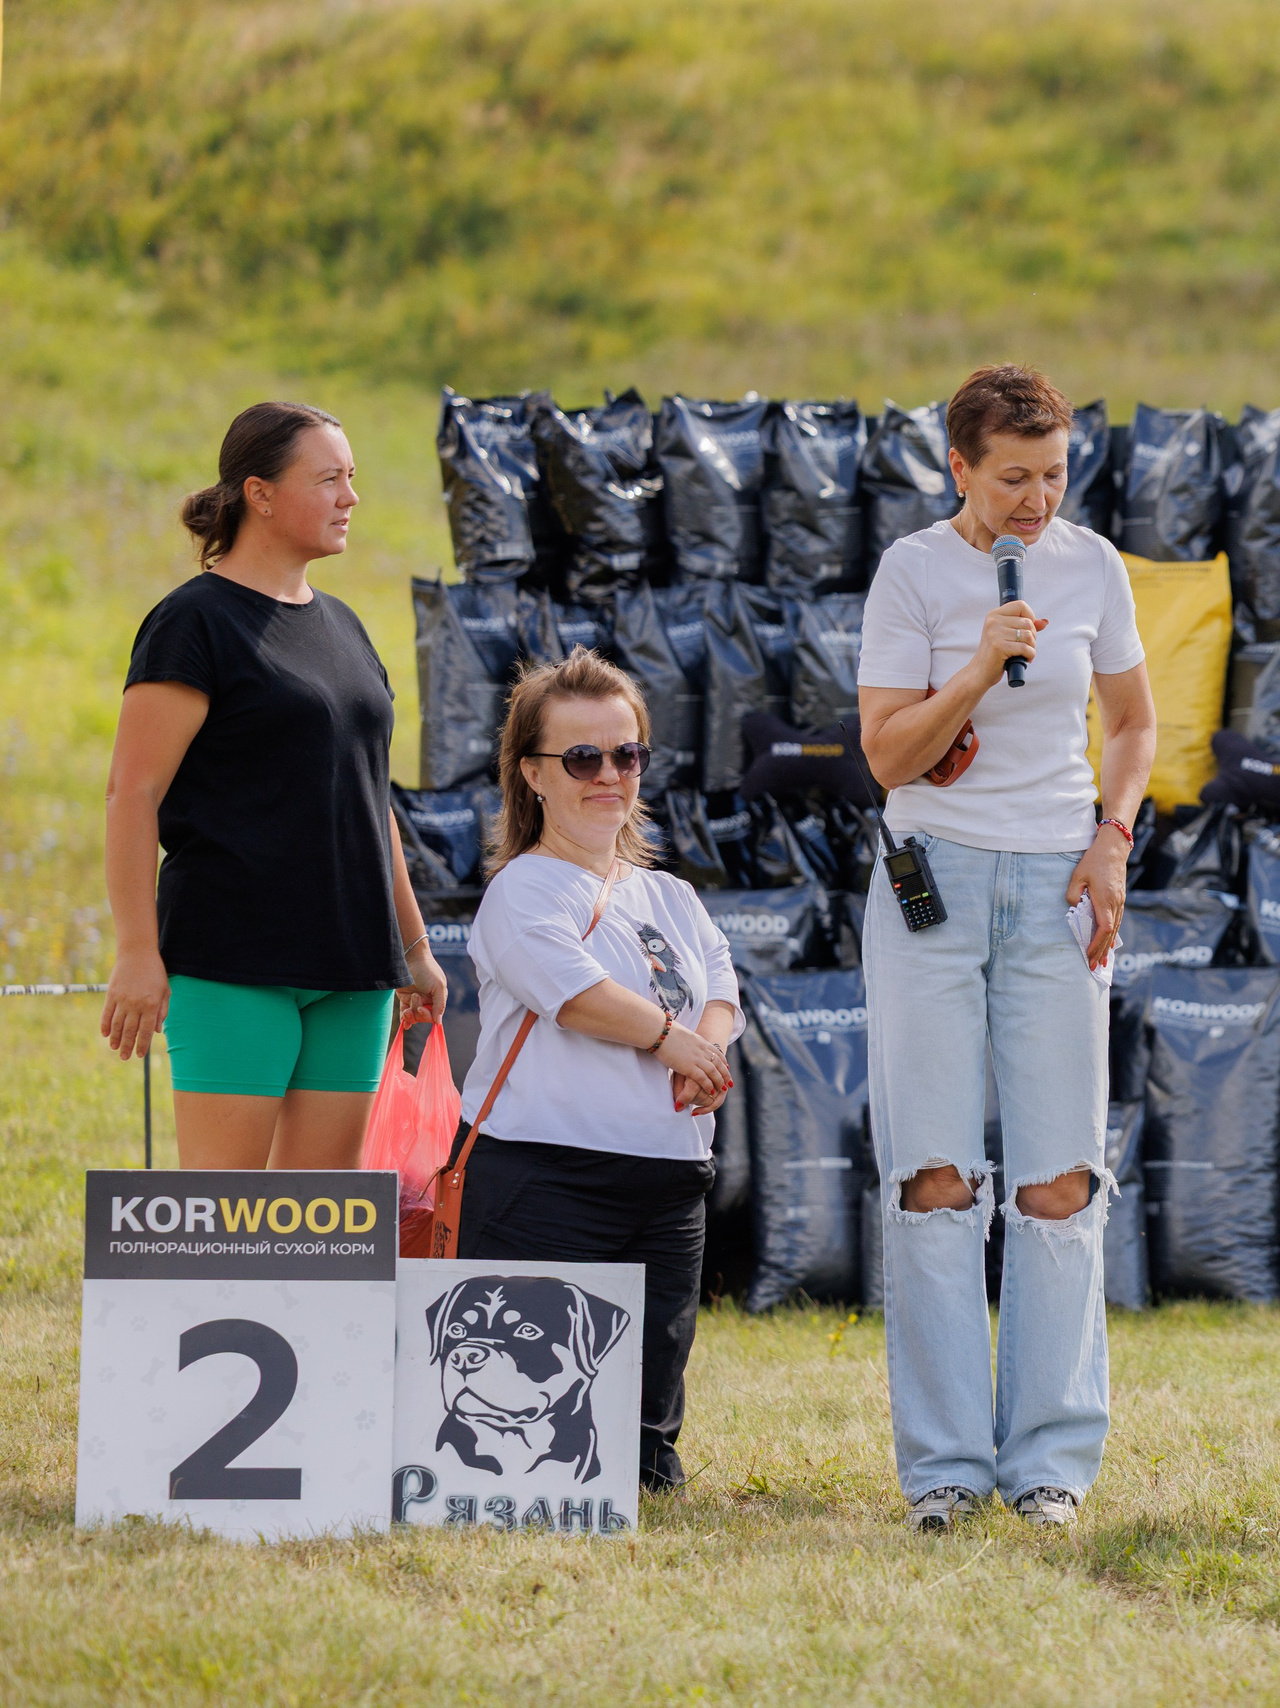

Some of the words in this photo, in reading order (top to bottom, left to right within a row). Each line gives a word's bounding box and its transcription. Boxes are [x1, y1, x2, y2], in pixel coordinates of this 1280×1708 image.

[110, 1195, 378, 1234] KORWOOD
[109, 1240, 270, 1256] ПОЛНОРАЦИОННЫЙ
[273, 1241, 327, 1255] СУХОЙ
[329, 1243, 375, 1255] КОРМ
[169, 1318, 302, 1500] 2
